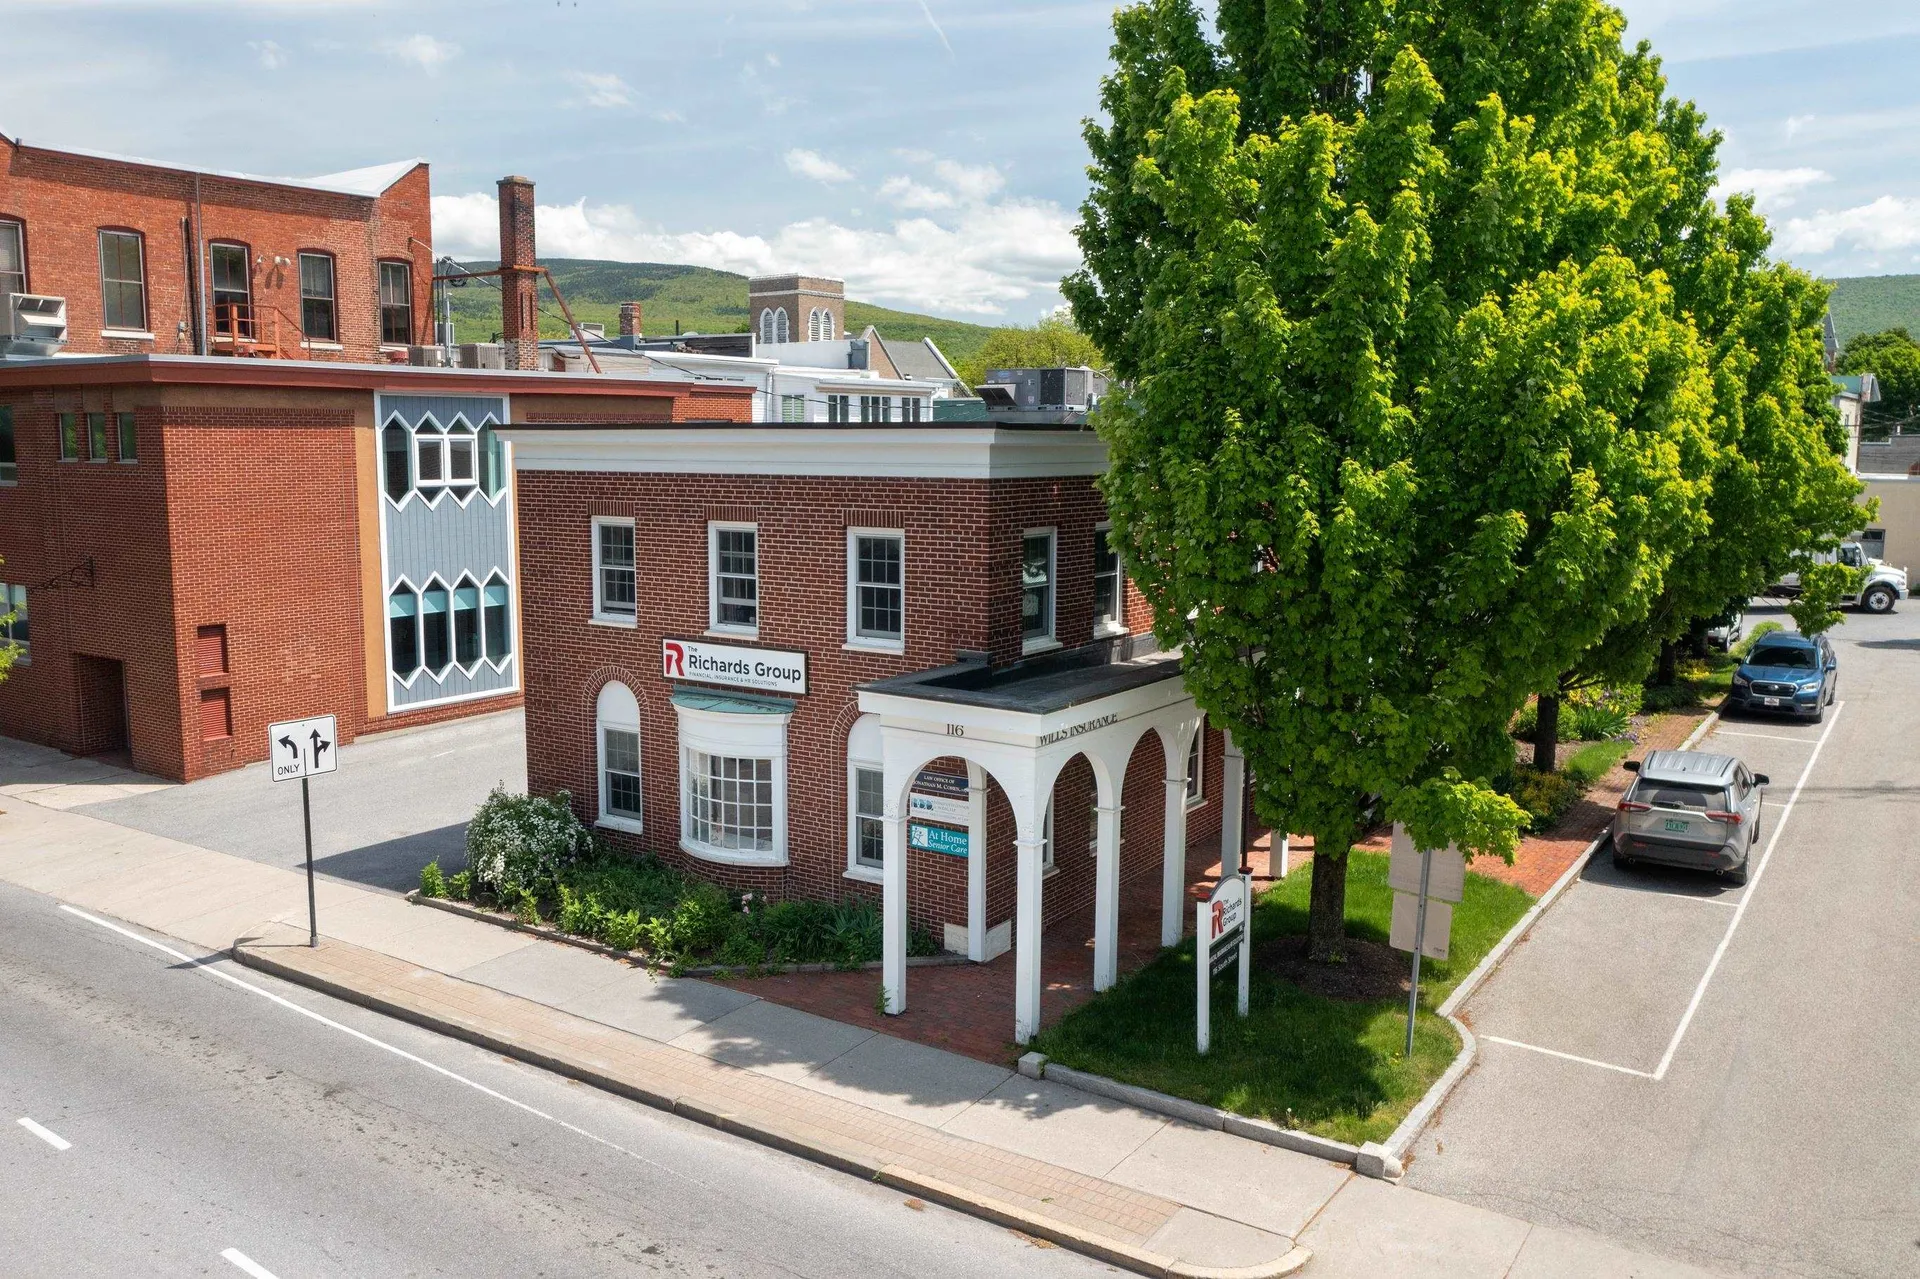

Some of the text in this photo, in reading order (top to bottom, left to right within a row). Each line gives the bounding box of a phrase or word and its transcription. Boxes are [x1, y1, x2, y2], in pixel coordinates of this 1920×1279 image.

[687, 645, 698, 653] The
[688, 654, 802, 683] Richards Group
[689, 671, 713, 680] FINANCIAL,
[714, 674, 740, 683] INSURANCE
[751, 679, 778, 687] SOLUTIONS
[946, 723, 964, 737] 116
[1039, 713, 1118, 746] WILLS INSURANCE
[277, 763, 300, 776] ONLY
[928, 829, 968, 845] At Home
[928, 840, 968, 854] Senior Care
[1223, 897, 1242, 915] Richards
[1223, 912, 1237, 927] Group
